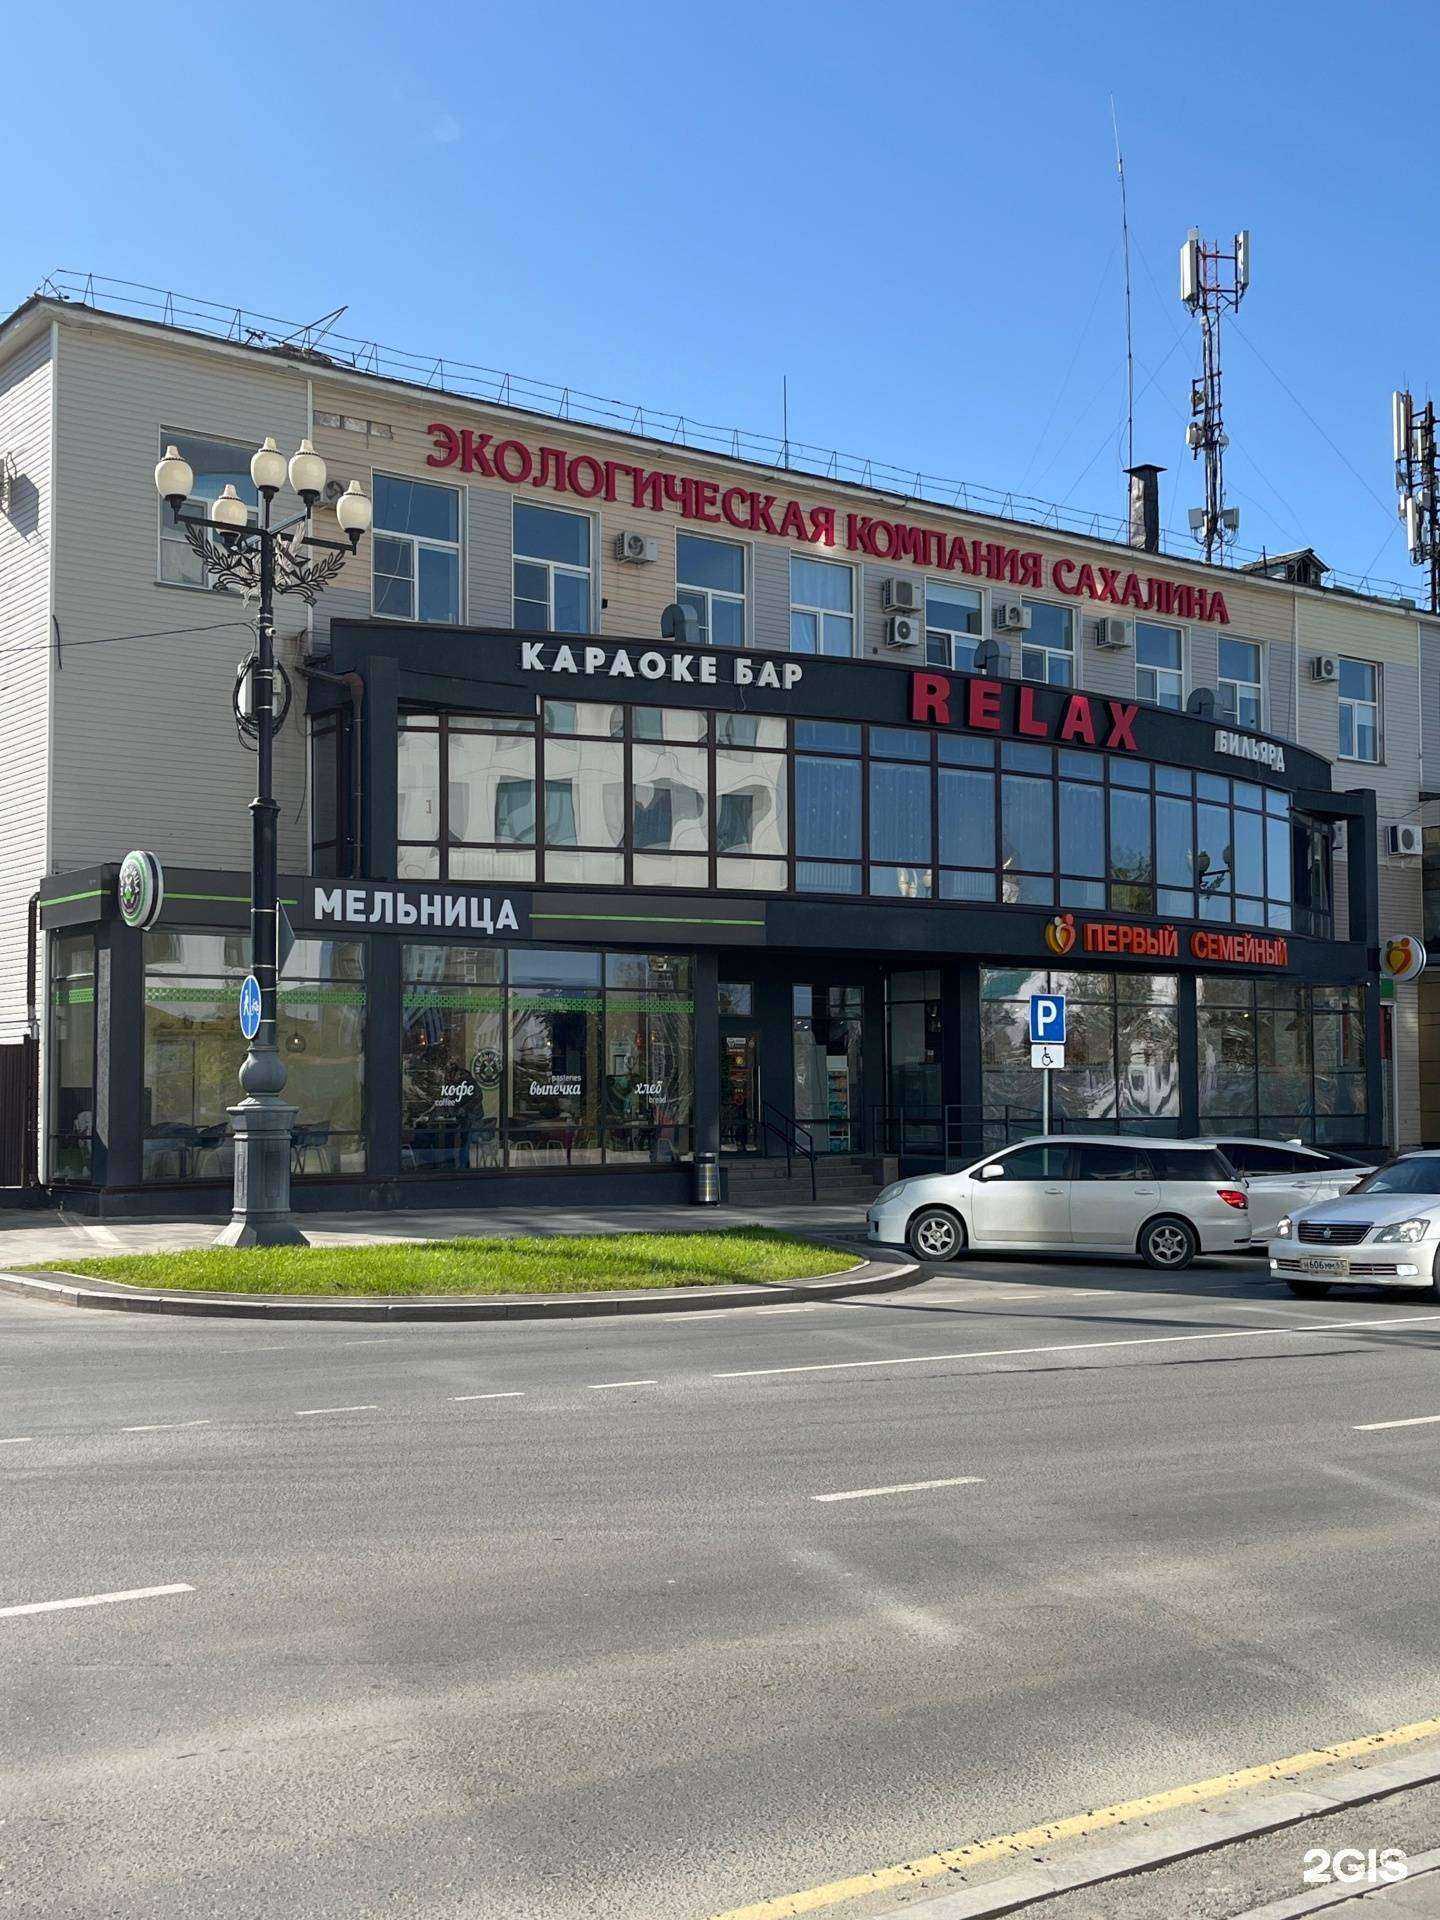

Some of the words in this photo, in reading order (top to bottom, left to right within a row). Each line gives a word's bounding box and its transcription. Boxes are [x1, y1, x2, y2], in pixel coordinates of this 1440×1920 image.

[426, 423, 836, 550] ЭКОЛОГИЧЕСКАЯ
[846, 513, 1044, 589] КОМПАНИЯ
[1051, 558, 1231, 626] САХАЛИНА
[521, 641, 718, 684] КАРАОКЕ
[733, 657, 803, 690] БАР
[911, 672, 1139, 750] RELAX
[1214, 729, 1286, 773] БИЛЬЯРД
[314, 887, 519, 935] МЕЛЬНИЦА
[1083, 923, 1179, 957] ПЕРВЫЙ
[1190, 931, 1289, 966] СЕМЕЙНЫЙ
[1037, 1000, 1058, 1037] P
[440, 1080, 475, 1103] кофе
[529, 1080, 582, 1096] выпечка
[634, 1080, 664, 1095] хлеб
